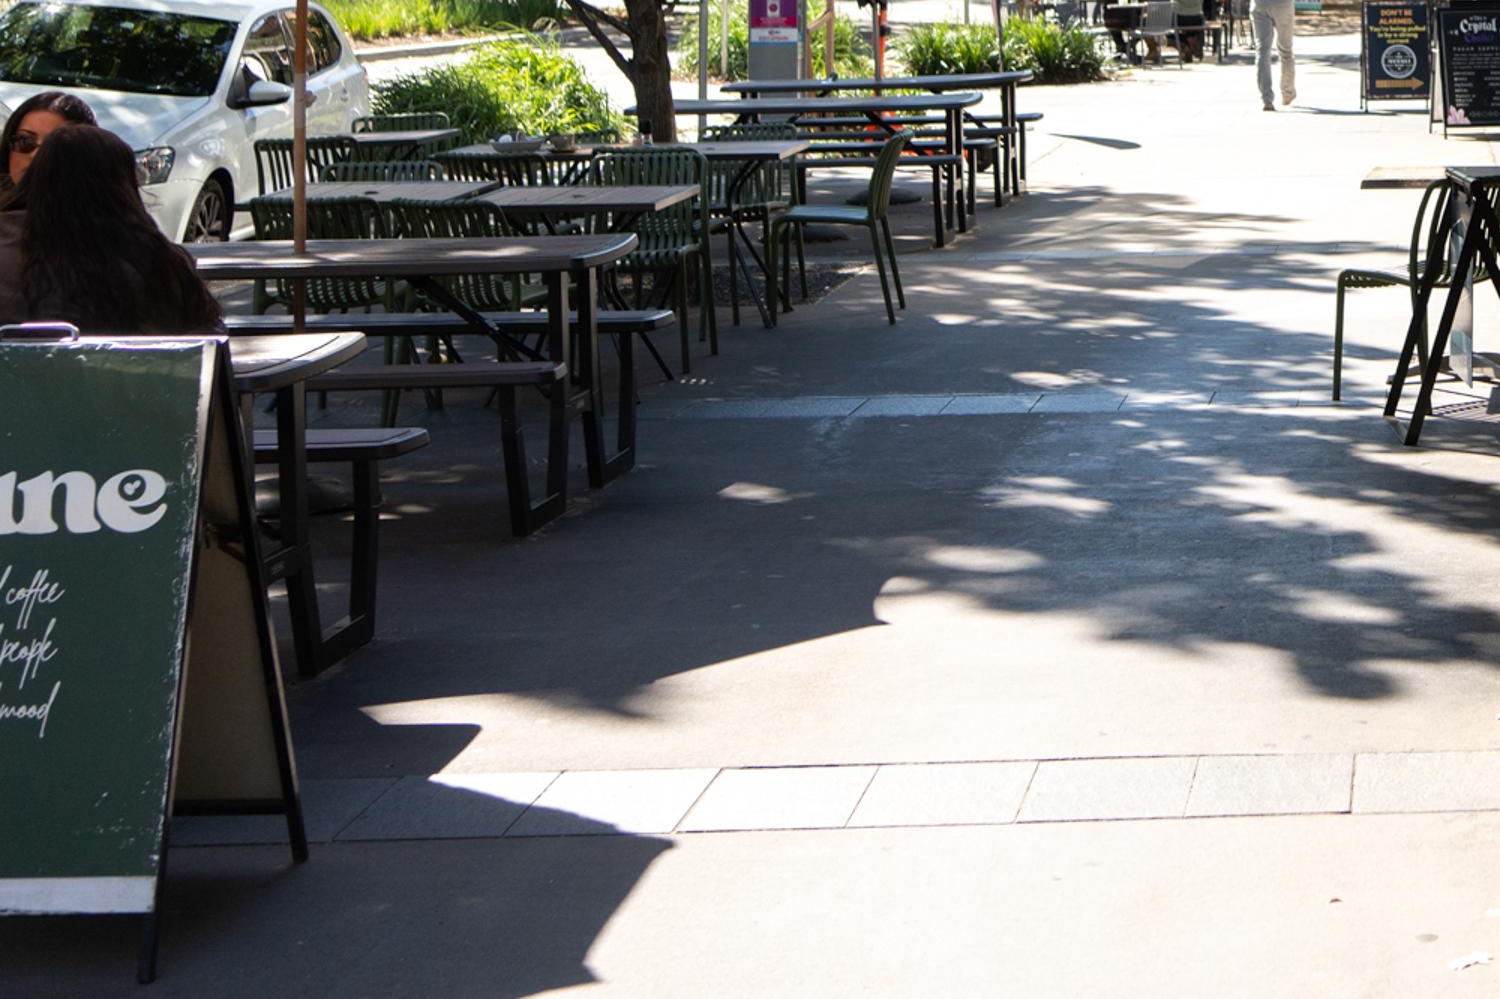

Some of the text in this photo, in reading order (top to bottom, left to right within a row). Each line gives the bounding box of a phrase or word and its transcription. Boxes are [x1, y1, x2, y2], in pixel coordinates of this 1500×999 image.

[1390, 25, 1407, 33] being
[1459, 16, 1497, 34] Crystal
[0, 469, 168, 534] ne
[5, 569, 66, 630] coffee
[0, 618, 58, 690] people
[0, 681, 62, 738] mood
